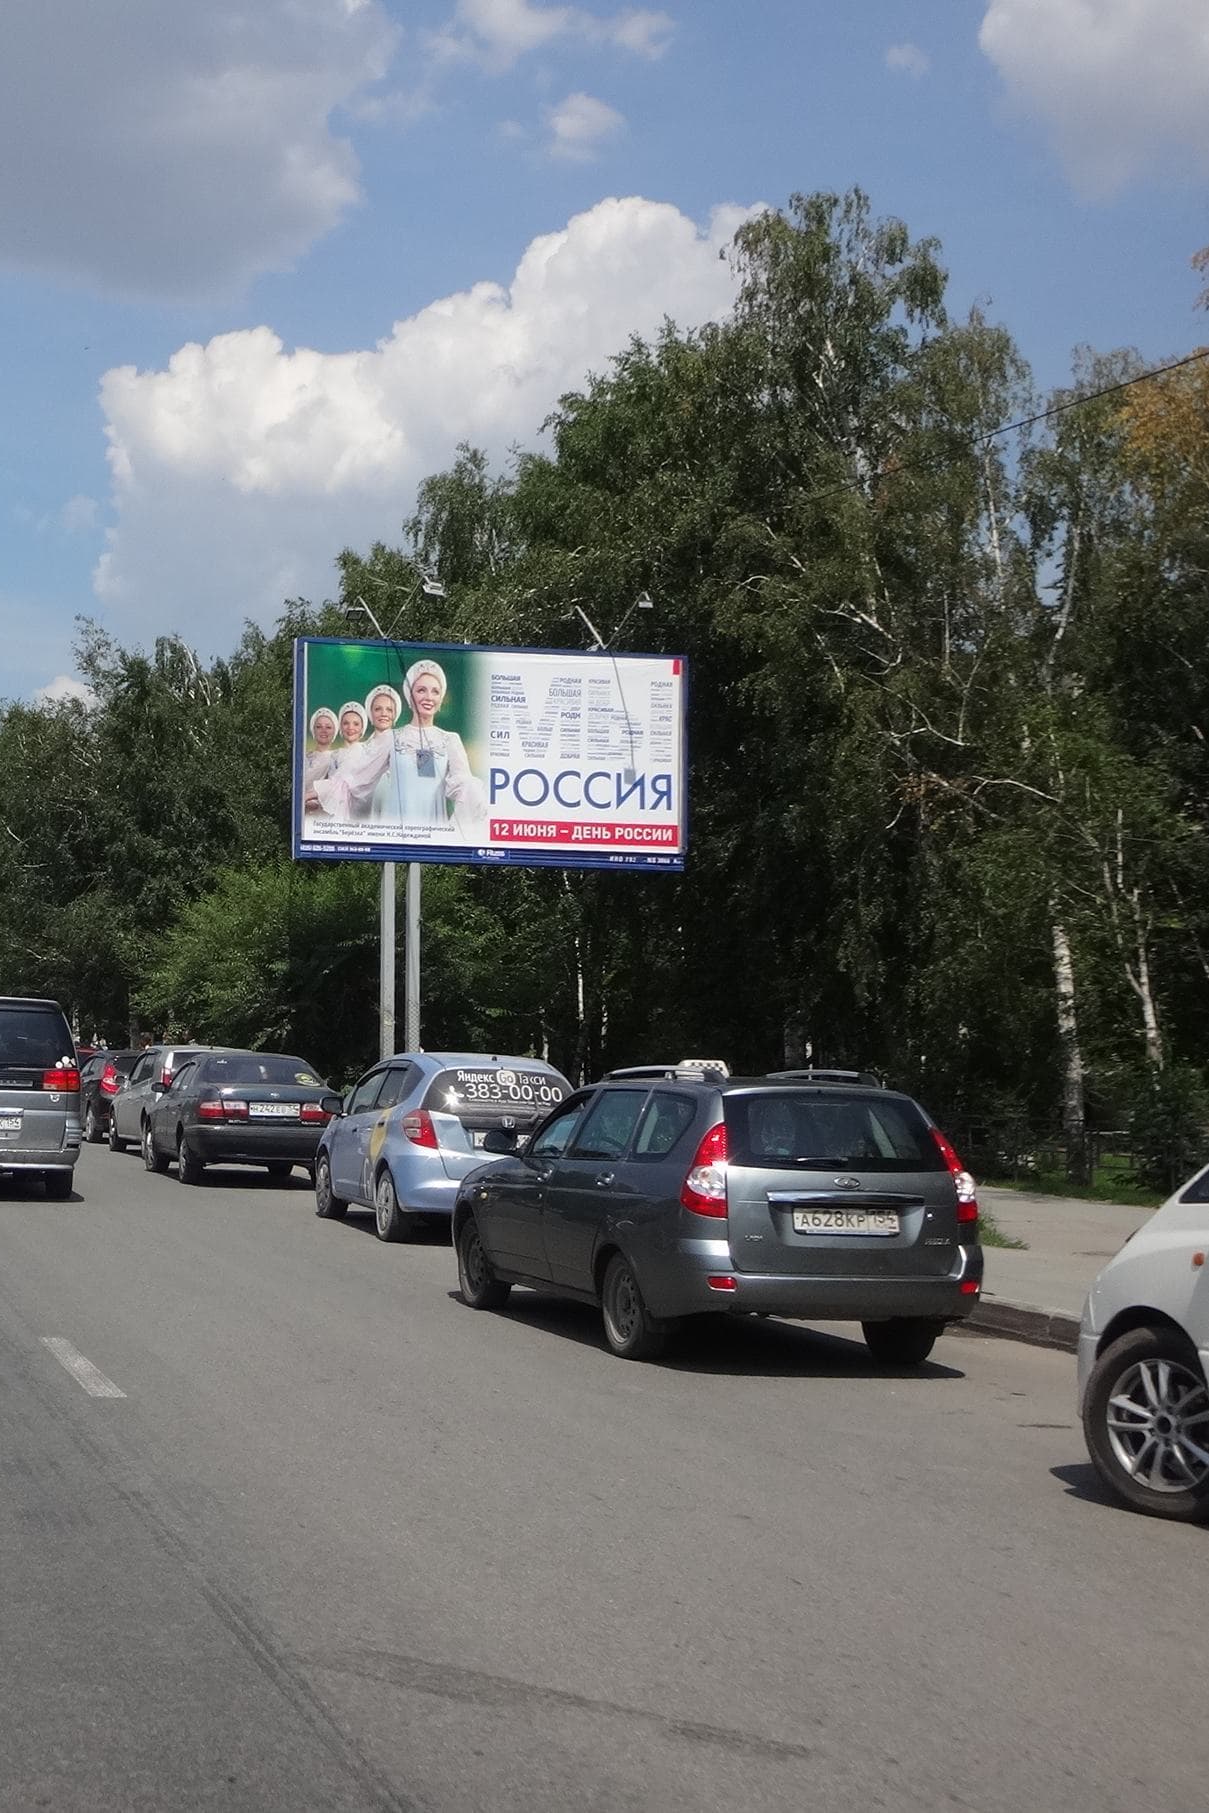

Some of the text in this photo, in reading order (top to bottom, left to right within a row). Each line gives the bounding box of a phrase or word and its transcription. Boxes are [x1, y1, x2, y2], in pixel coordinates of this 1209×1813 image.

[491, 695, 526, 703] СИЛЬНАЯ
[548, 688, 582, 698] БОЛЬШАЯ
[490, 730, 510, 739] СИЛ
[489, 767, 672, 811] РОССИЯ
[493, 823, 509, 836] 12
[513, 824, 557, 837] ИЮНЯ
[571, 826, 611, 840] ДЕНЬ
[615, 827, 673, 841] РОССИИ
[457, 1070, 546, 1085] Яндекс Go Такси
[465, 1083, 563, 1102] 383-00-00
